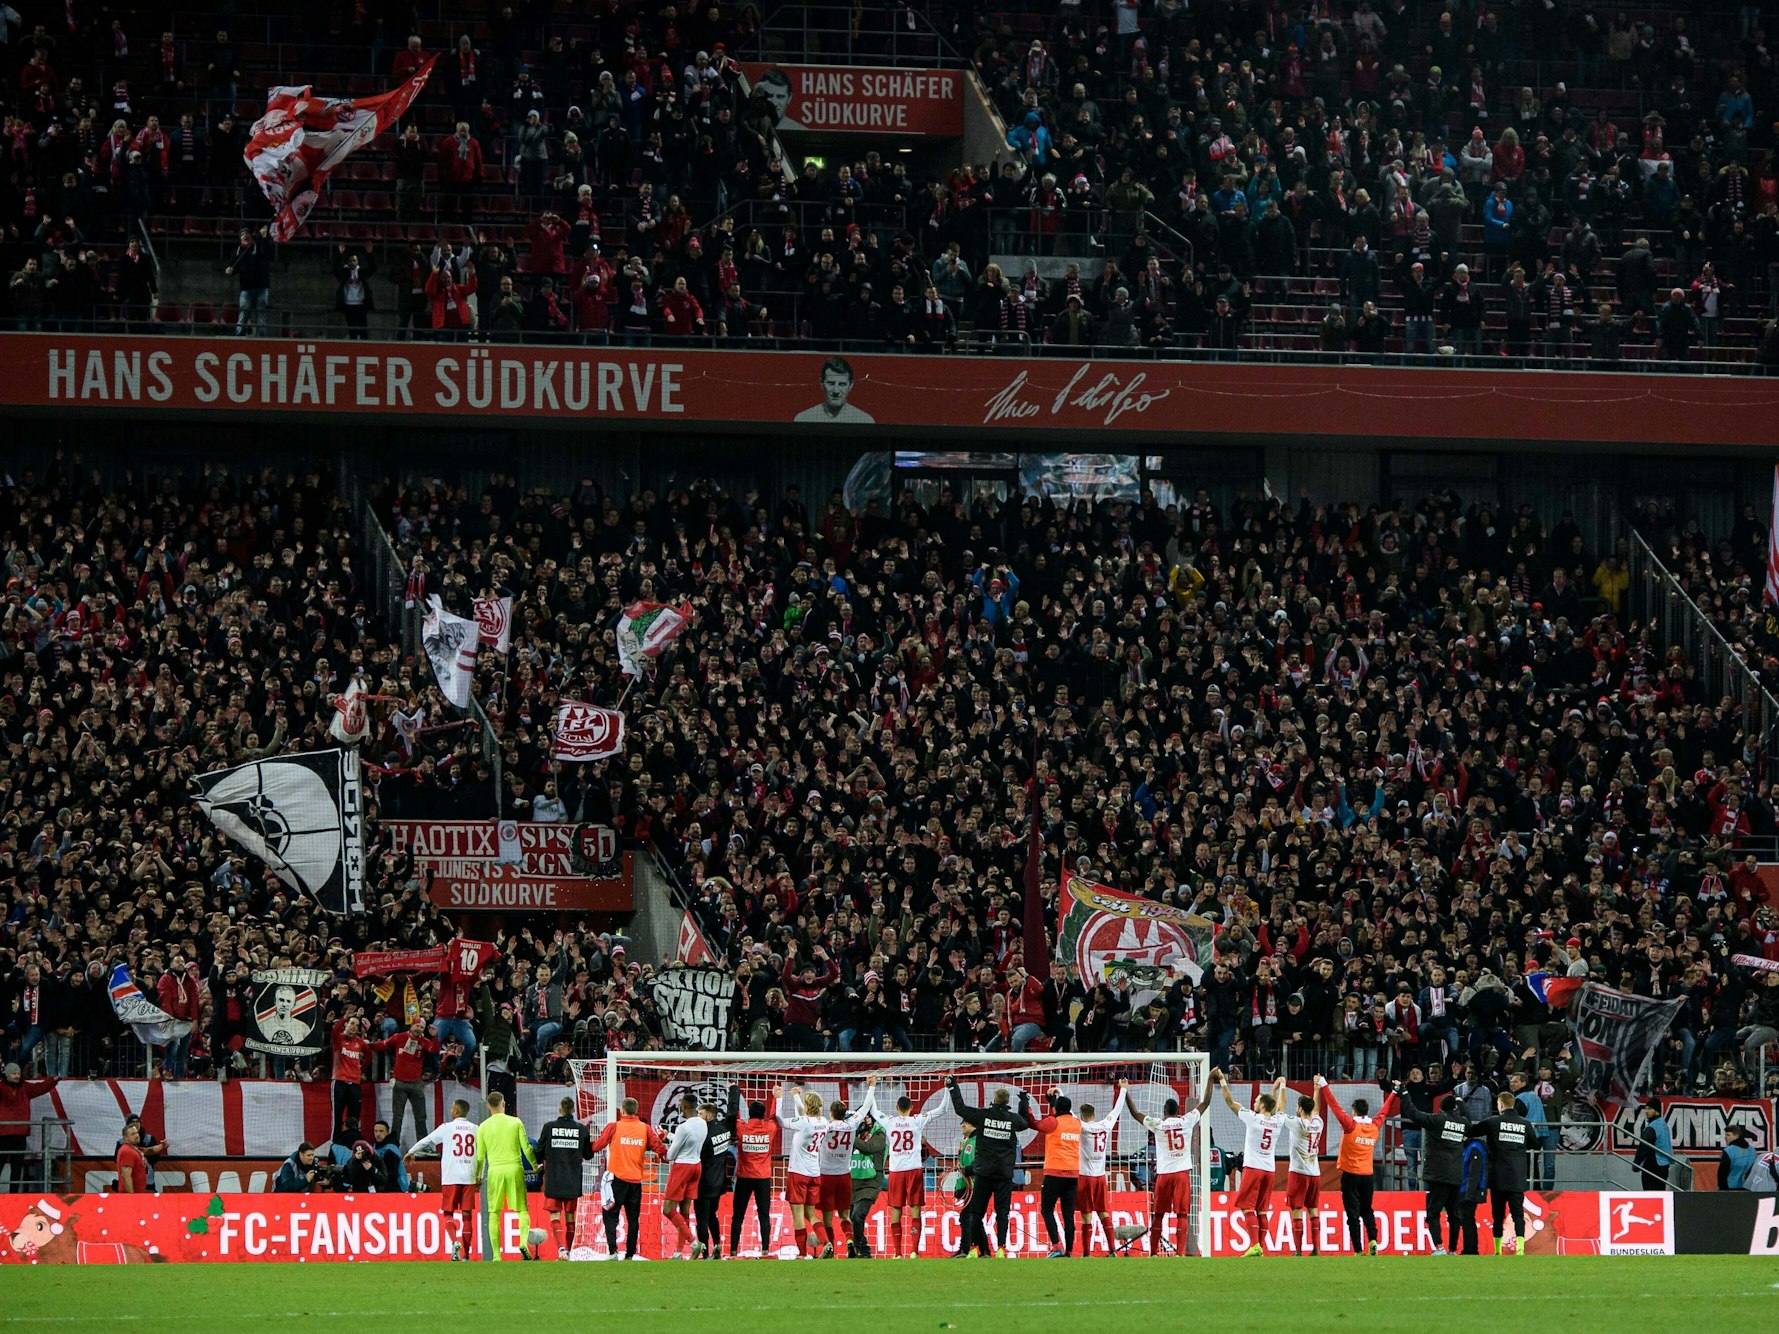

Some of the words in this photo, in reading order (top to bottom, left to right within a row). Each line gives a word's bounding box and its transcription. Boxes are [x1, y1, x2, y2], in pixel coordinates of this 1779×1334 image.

[802, 72, 854, 95] HANS
[862, 72, 953, 99] SCHÄFER
[801, 98, 907, 127] SÜDKURVE
[48, 349, 172, 400] HANS
[194, 345, 413, 406] SCHÄFER
[435, 350, 685, 412] SÜDKURVE
[390, 825, 494, 855] HAOTIX
[459, 949, 479, 971] 10
[984, 1118, 1012, 1130] REWE
[1444, 1121, 1466, 1133] REWE
[1500, 1122, 1526, 1133] REWE
[551, 1128, 580, 1138] REWE
[711, 1131, 732, 1146] REWE
[742, 1134, 770, 1144] REWE
[984, 1130, 1011, 1140] uhlsport
[1060, 1132, 1080, 1142] REWE
[1164, 1128, 1185, 1151] 15
[1260, 1129, 1272, 1150] 5
[1500, 1134, 1524, 1143] uhlsport
[452, 1133, 475, 1157] 38
[552, 1140, 579, 1149] uhlsport
[620, 1137, 643, 1147] REWE
[827, 1131, 851, 1150] 34
[891, 1130, 914, 1153] 28
[1091, 1131, 1107, 1152] 13
[1354, 1136, 1376, 1146] REWE
[742, 1144, 769, 1153] uhlsport
[918, 1211, 962, 1252] FC
[1610, 1248, 1665, 1256] BUNDESLIGA
